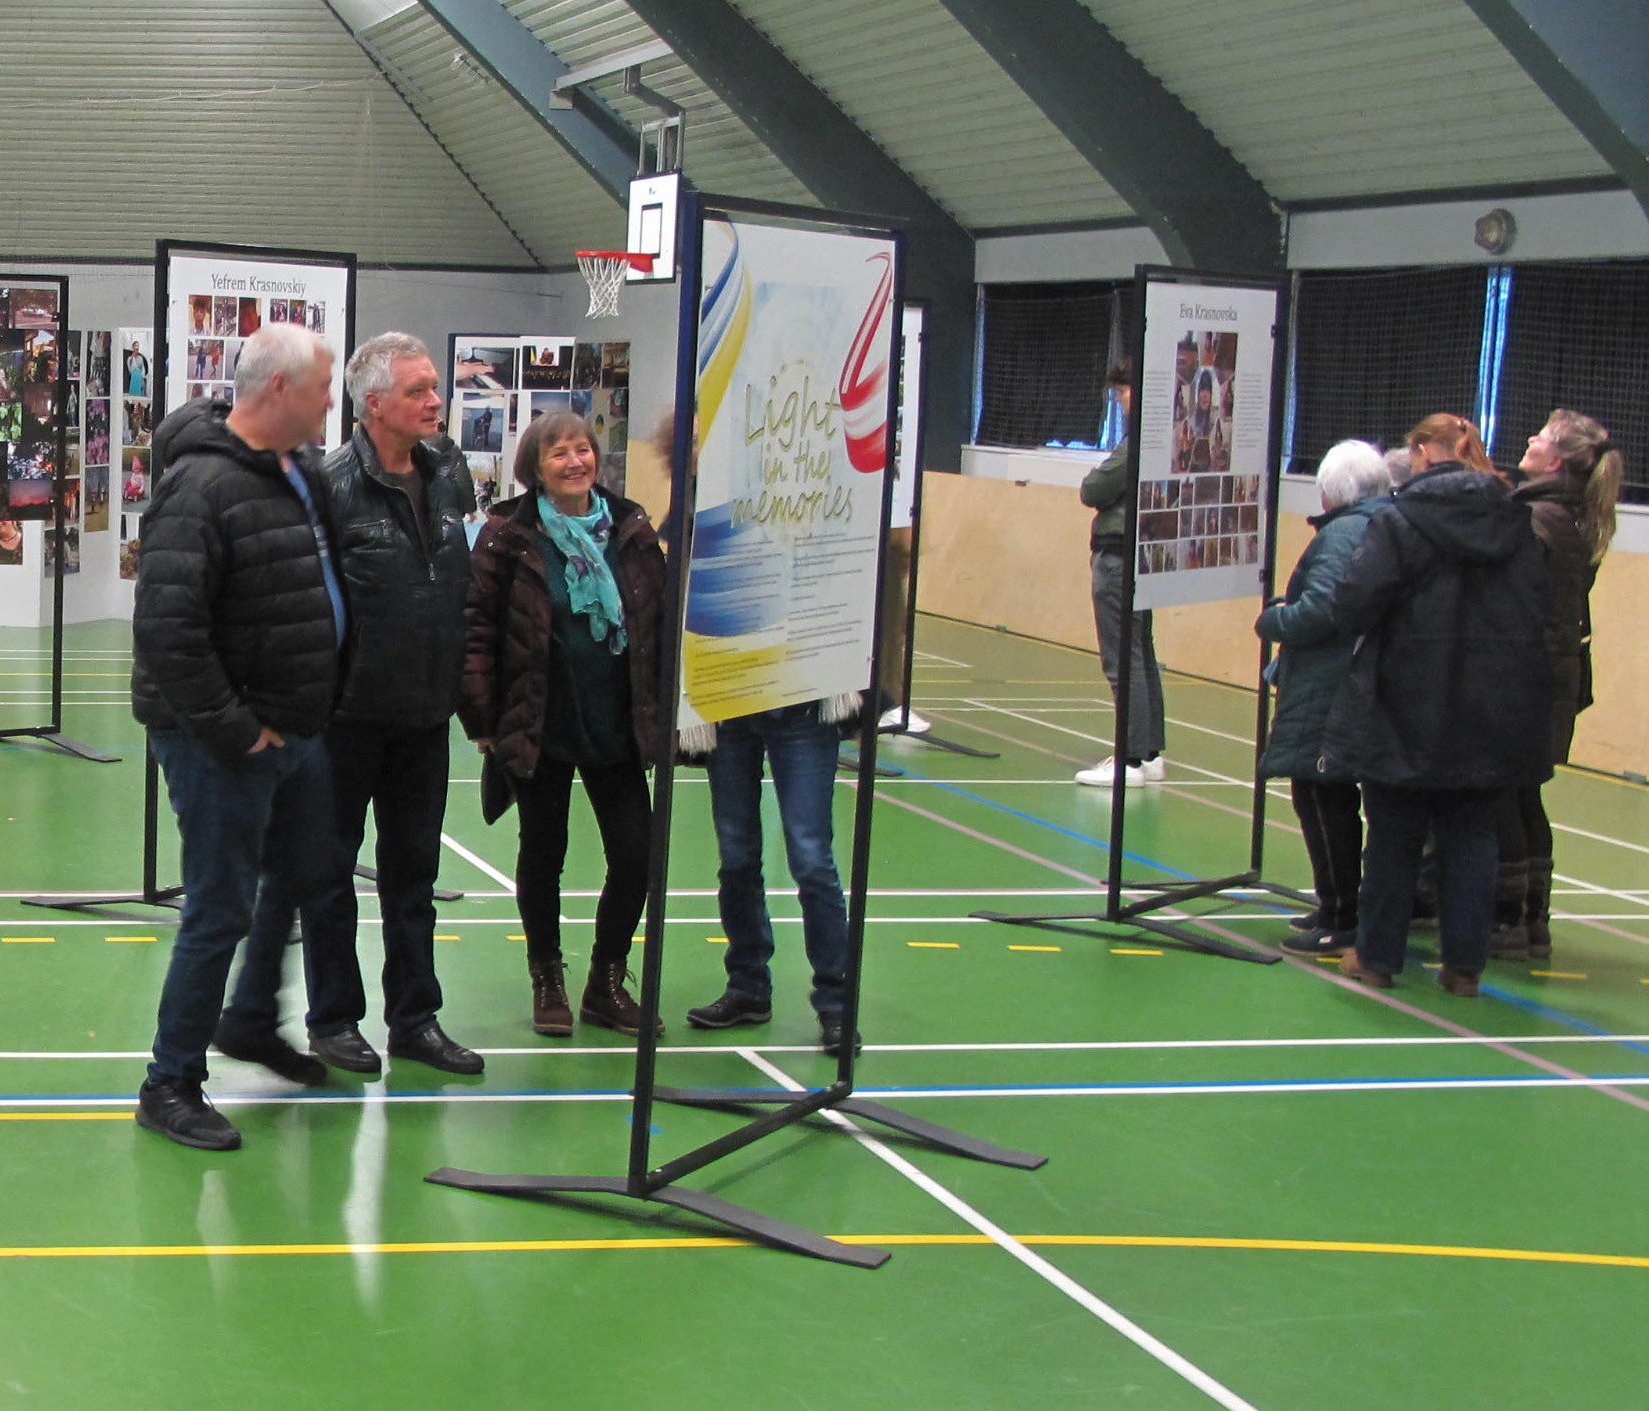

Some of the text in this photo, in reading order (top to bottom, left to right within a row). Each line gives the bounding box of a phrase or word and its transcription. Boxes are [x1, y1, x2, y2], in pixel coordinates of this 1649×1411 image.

[211, 274, 307, 297] Yefrem Krasnovskiy
[1179, 303, 1194, 319] Eva
[745, 375, 841, 452] Light
[764, 443, 789, 485] in
[730, 485, 853, 529] memories
